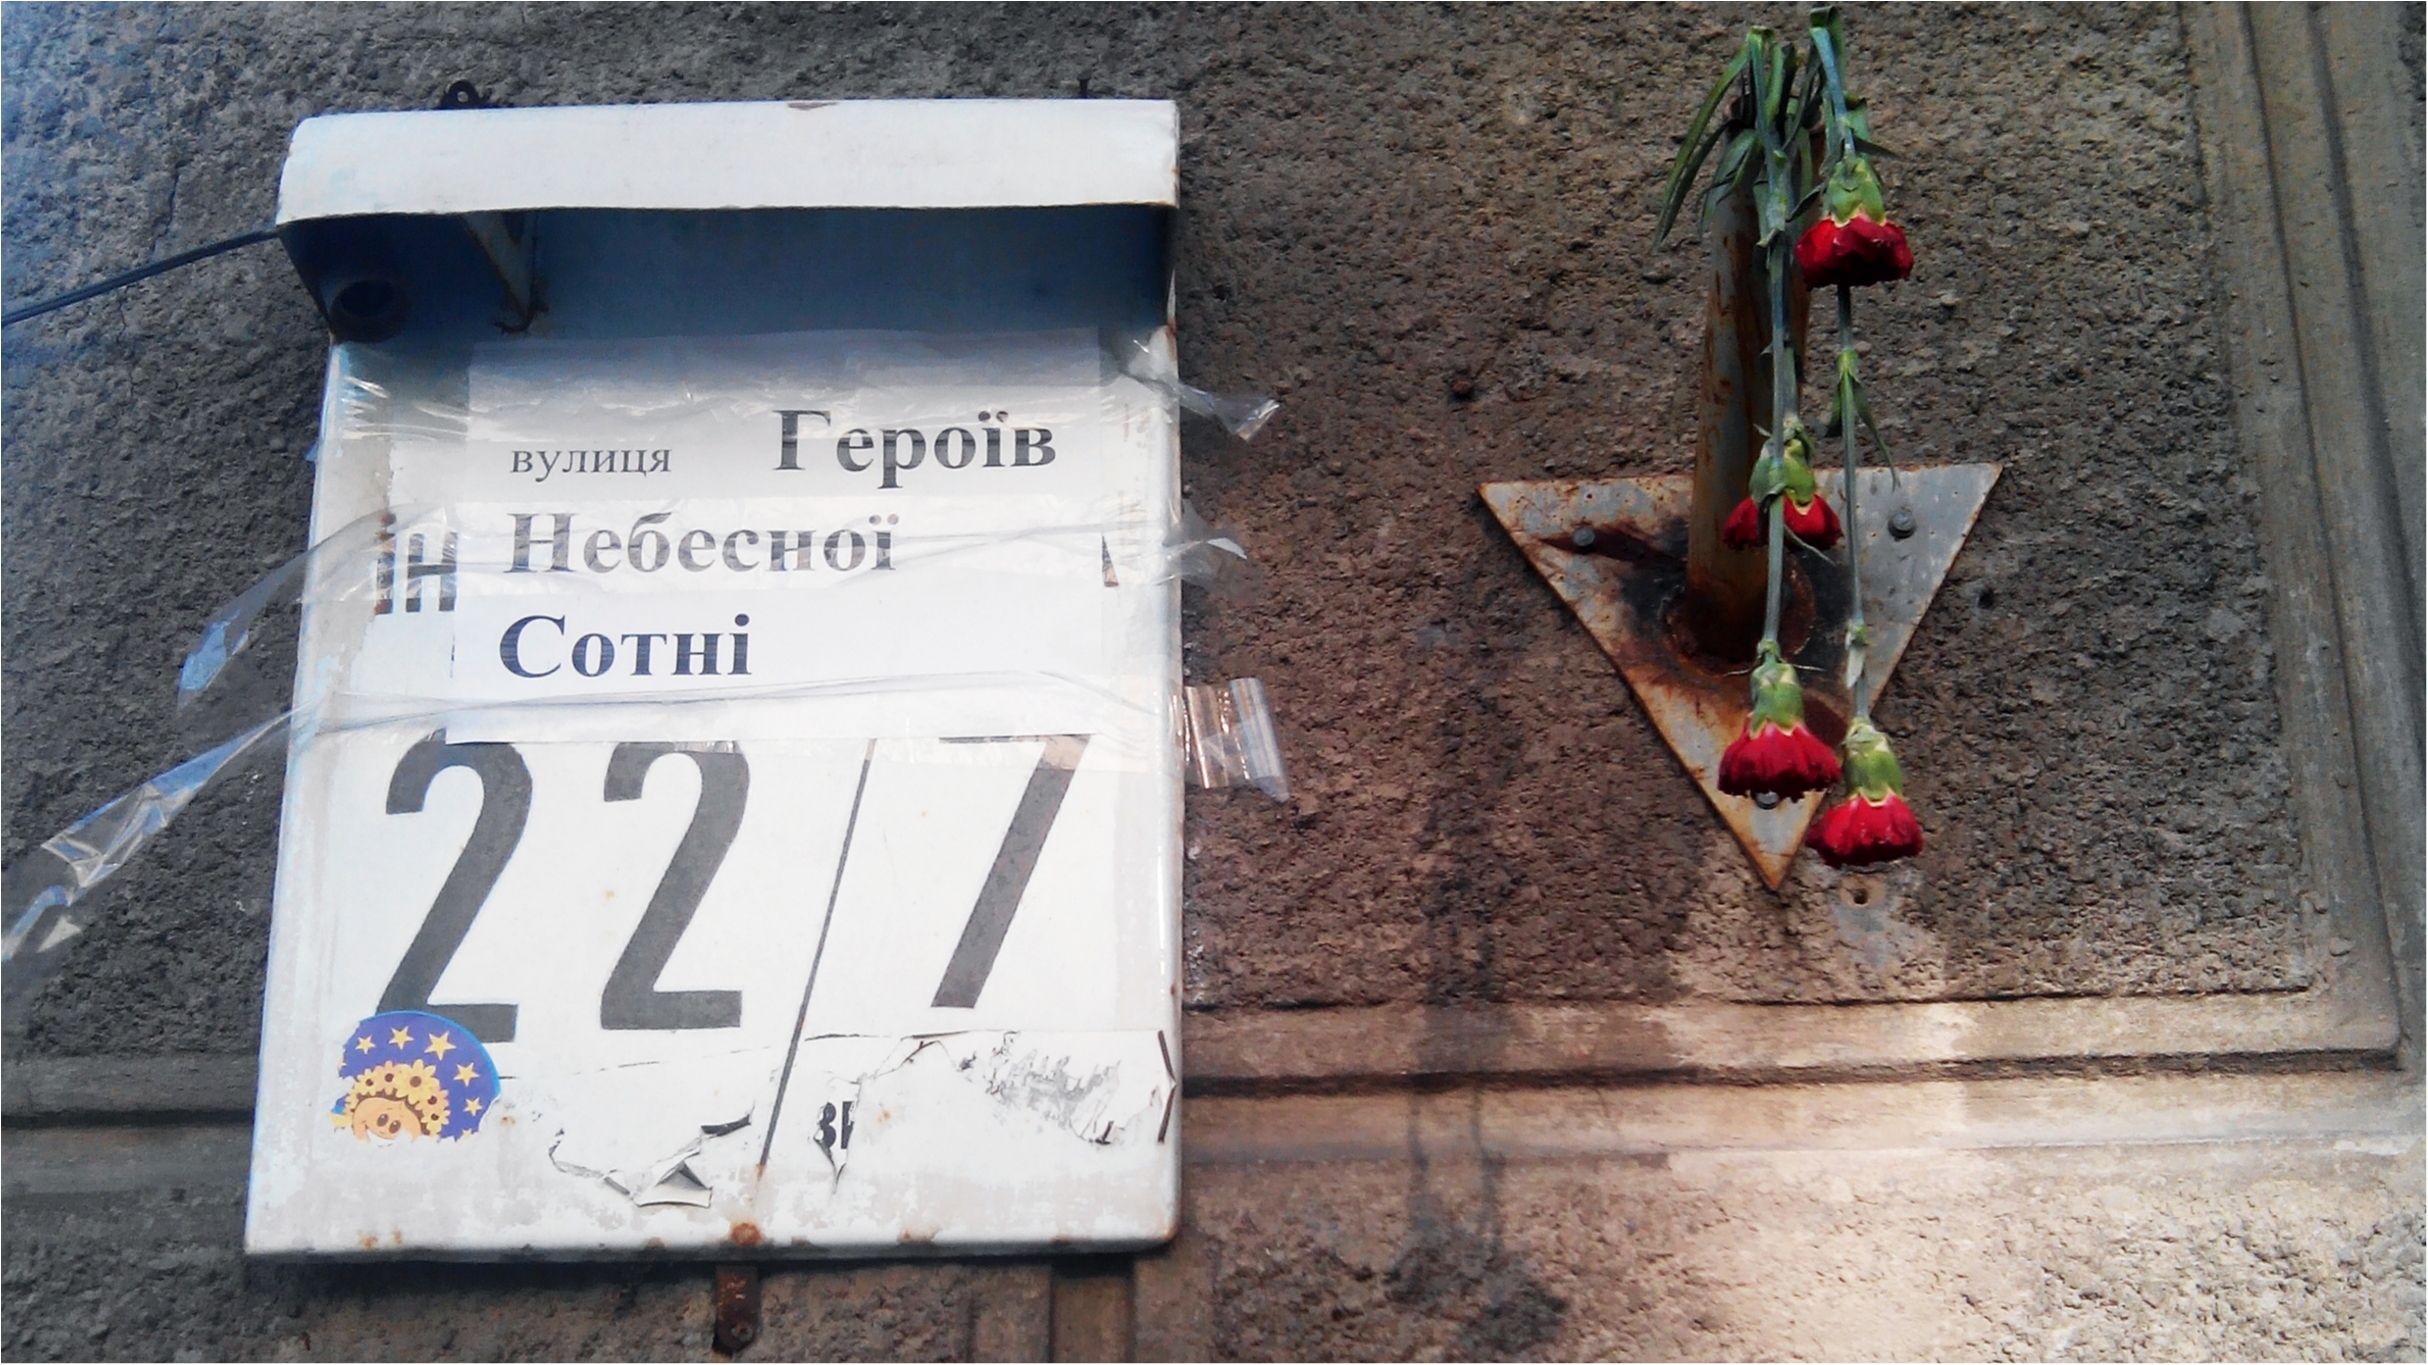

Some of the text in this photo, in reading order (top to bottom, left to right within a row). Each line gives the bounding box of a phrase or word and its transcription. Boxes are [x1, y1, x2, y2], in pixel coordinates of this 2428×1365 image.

[511, 409, 1056, 489] вулиця Героїв
[503, 511, 899, 573] Небесної
[500, 613, 751, 679] Сотні
